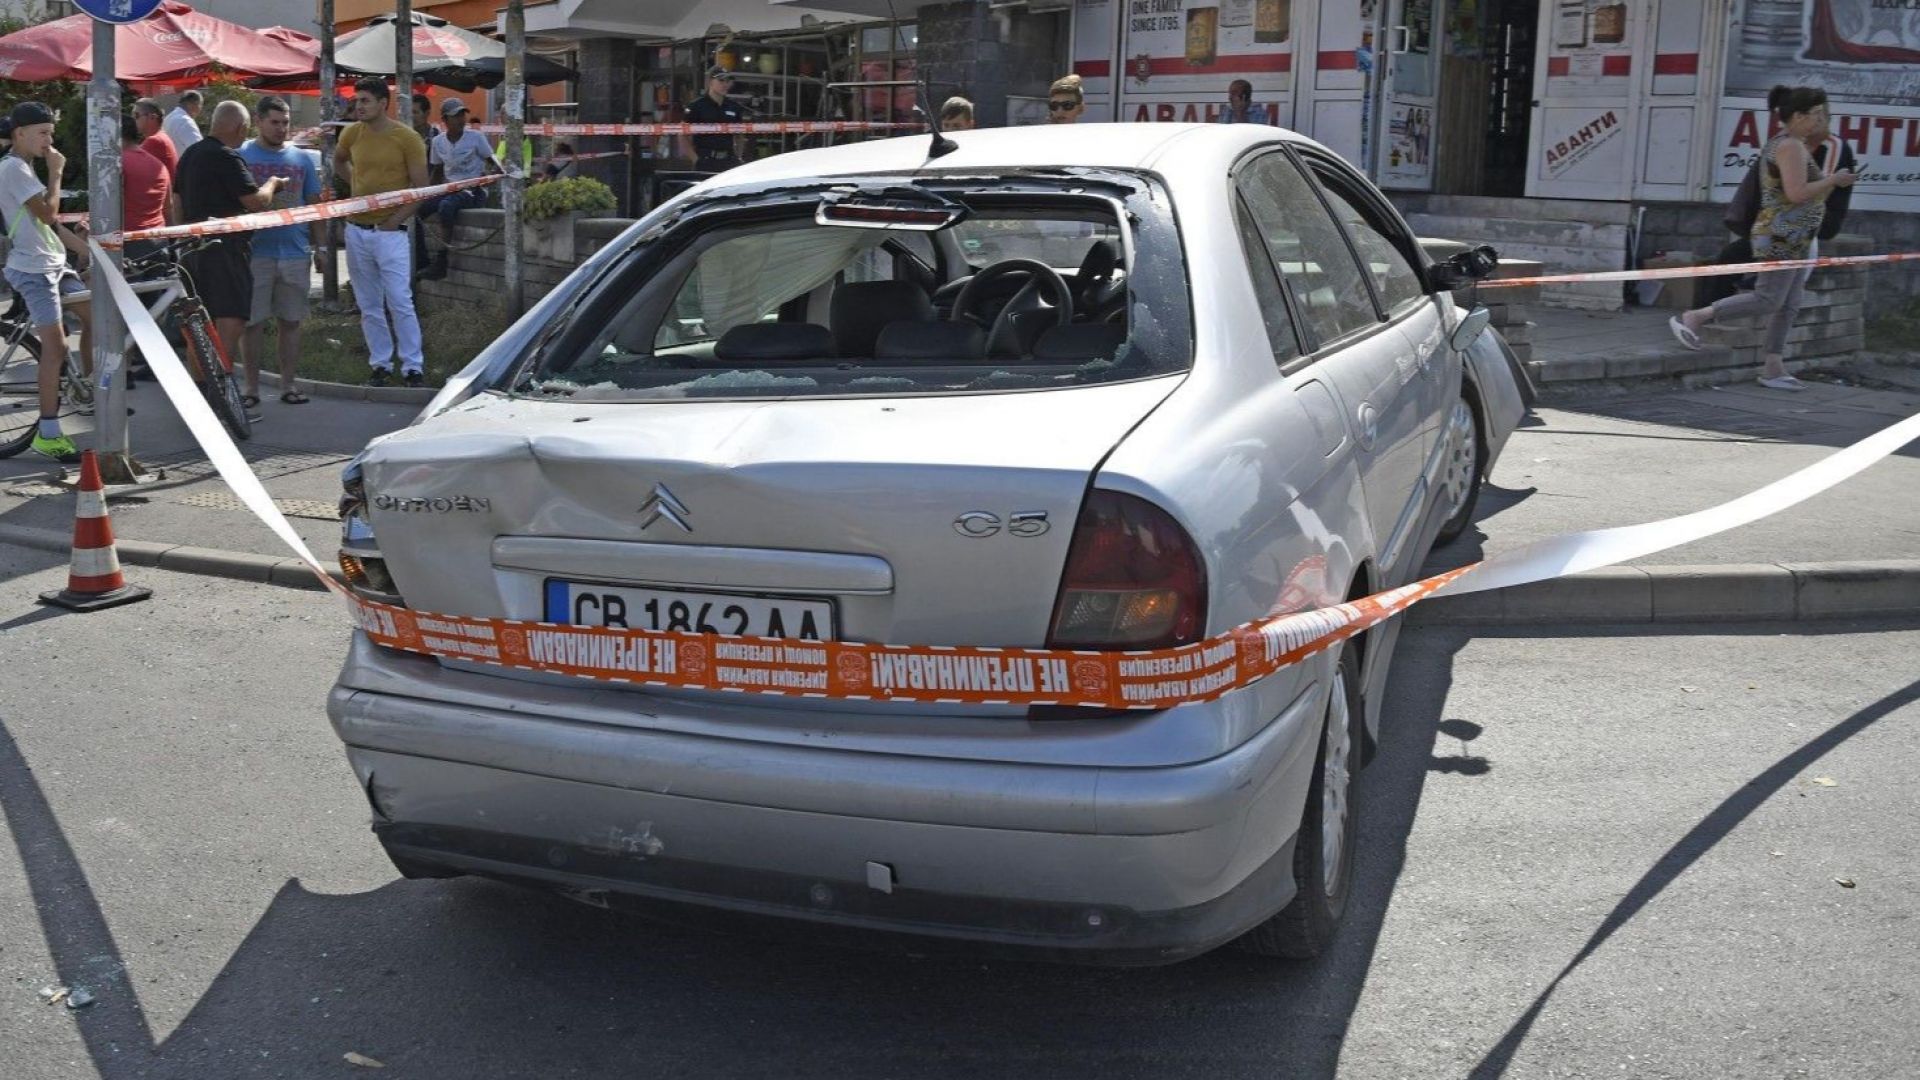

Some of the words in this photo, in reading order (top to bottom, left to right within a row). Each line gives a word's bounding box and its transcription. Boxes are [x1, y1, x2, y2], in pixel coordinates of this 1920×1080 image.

[1131, 18, 1157, 32] SINCE
[1132, 0, 1149, 15] ONE
[1546, 110, 1618, 165] АВАНТИ
[951, 510, 1052, 538] C5
[575, 592, 629, 629] CB
[645, 598, 749, 635] 1862
[767, 607, 819, 640] AA
[526, 629, 650, 672] ПРЕМИНАВАЙ!
[653, 638, 677, 674] НЕ
[870, 652, 1035, 695] ПРЕМИНАВАЙ!
[1038, 658, 1070, 692] НЕ
